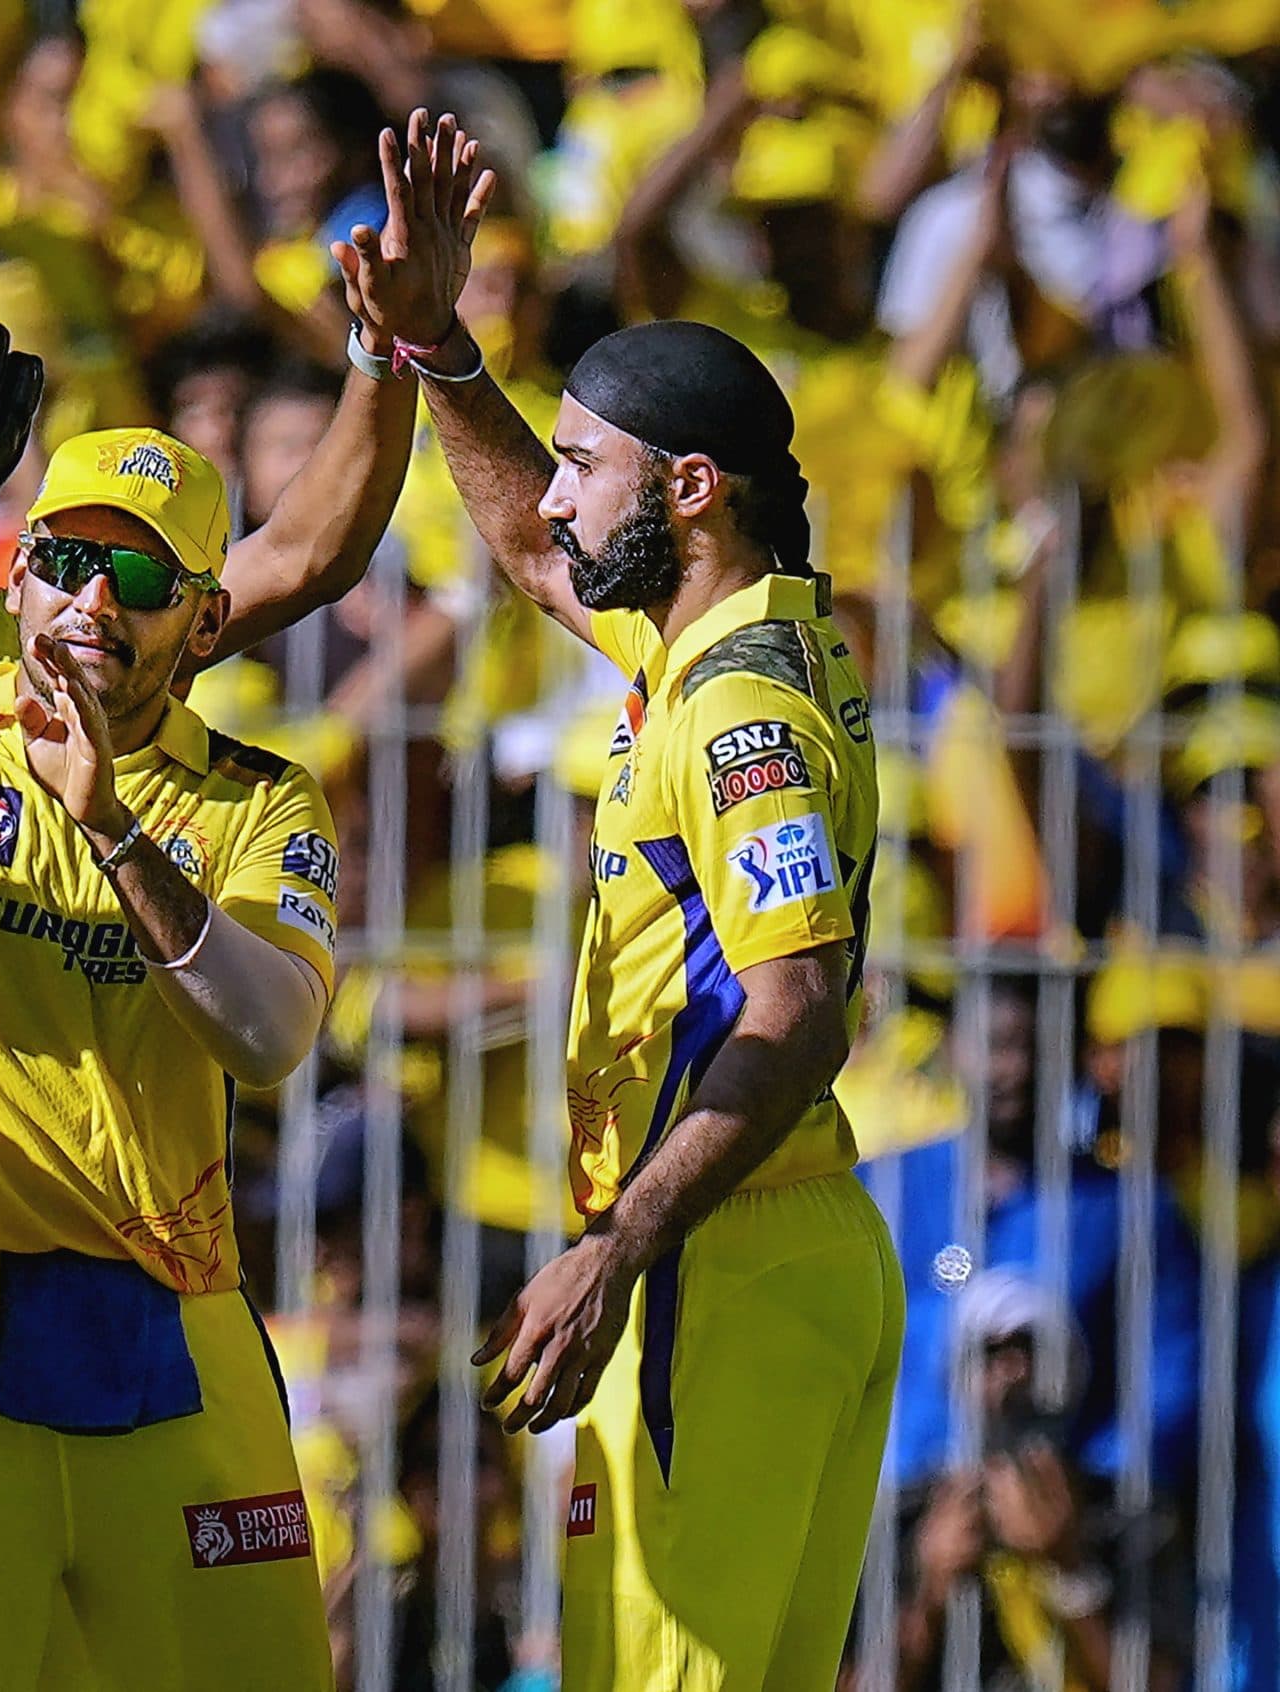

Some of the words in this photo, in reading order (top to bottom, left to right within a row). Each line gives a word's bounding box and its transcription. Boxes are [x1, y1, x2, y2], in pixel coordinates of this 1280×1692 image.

[711, 723, 782, 767] SNJ
[712, 753, 806, 811] 10000
[776, 847, 815, 863] TATA
[776, 858, 832, 897] IPL
[237, 1502, 305, 1530] BRITISH
[241, 1524, 308, 1551] EMPIRE
